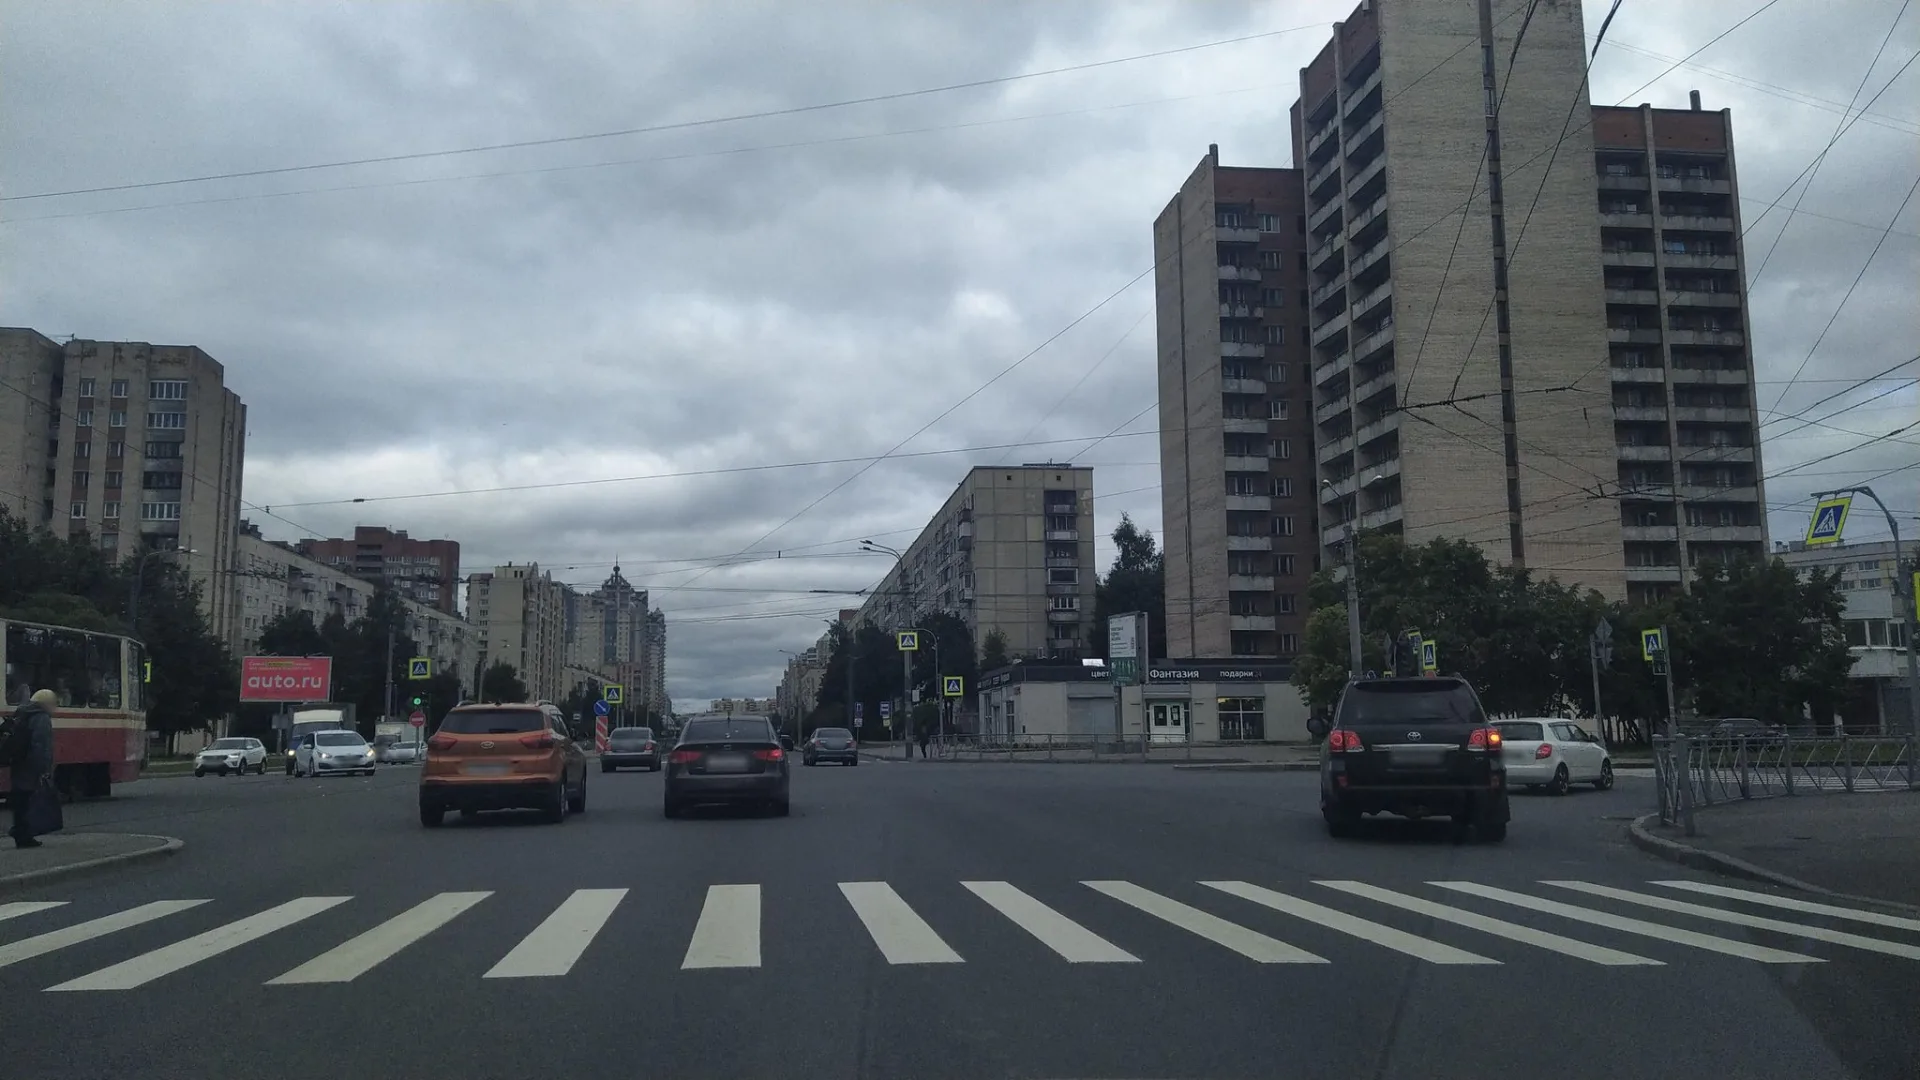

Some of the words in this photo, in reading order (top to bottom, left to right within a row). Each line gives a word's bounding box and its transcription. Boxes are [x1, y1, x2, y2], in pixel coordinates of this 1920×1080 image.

[1149, 669, 1199, 679] Фантазия
[1219, 670, 1254, 679] подарки
[247, 674, 322, 688] auto.ru
